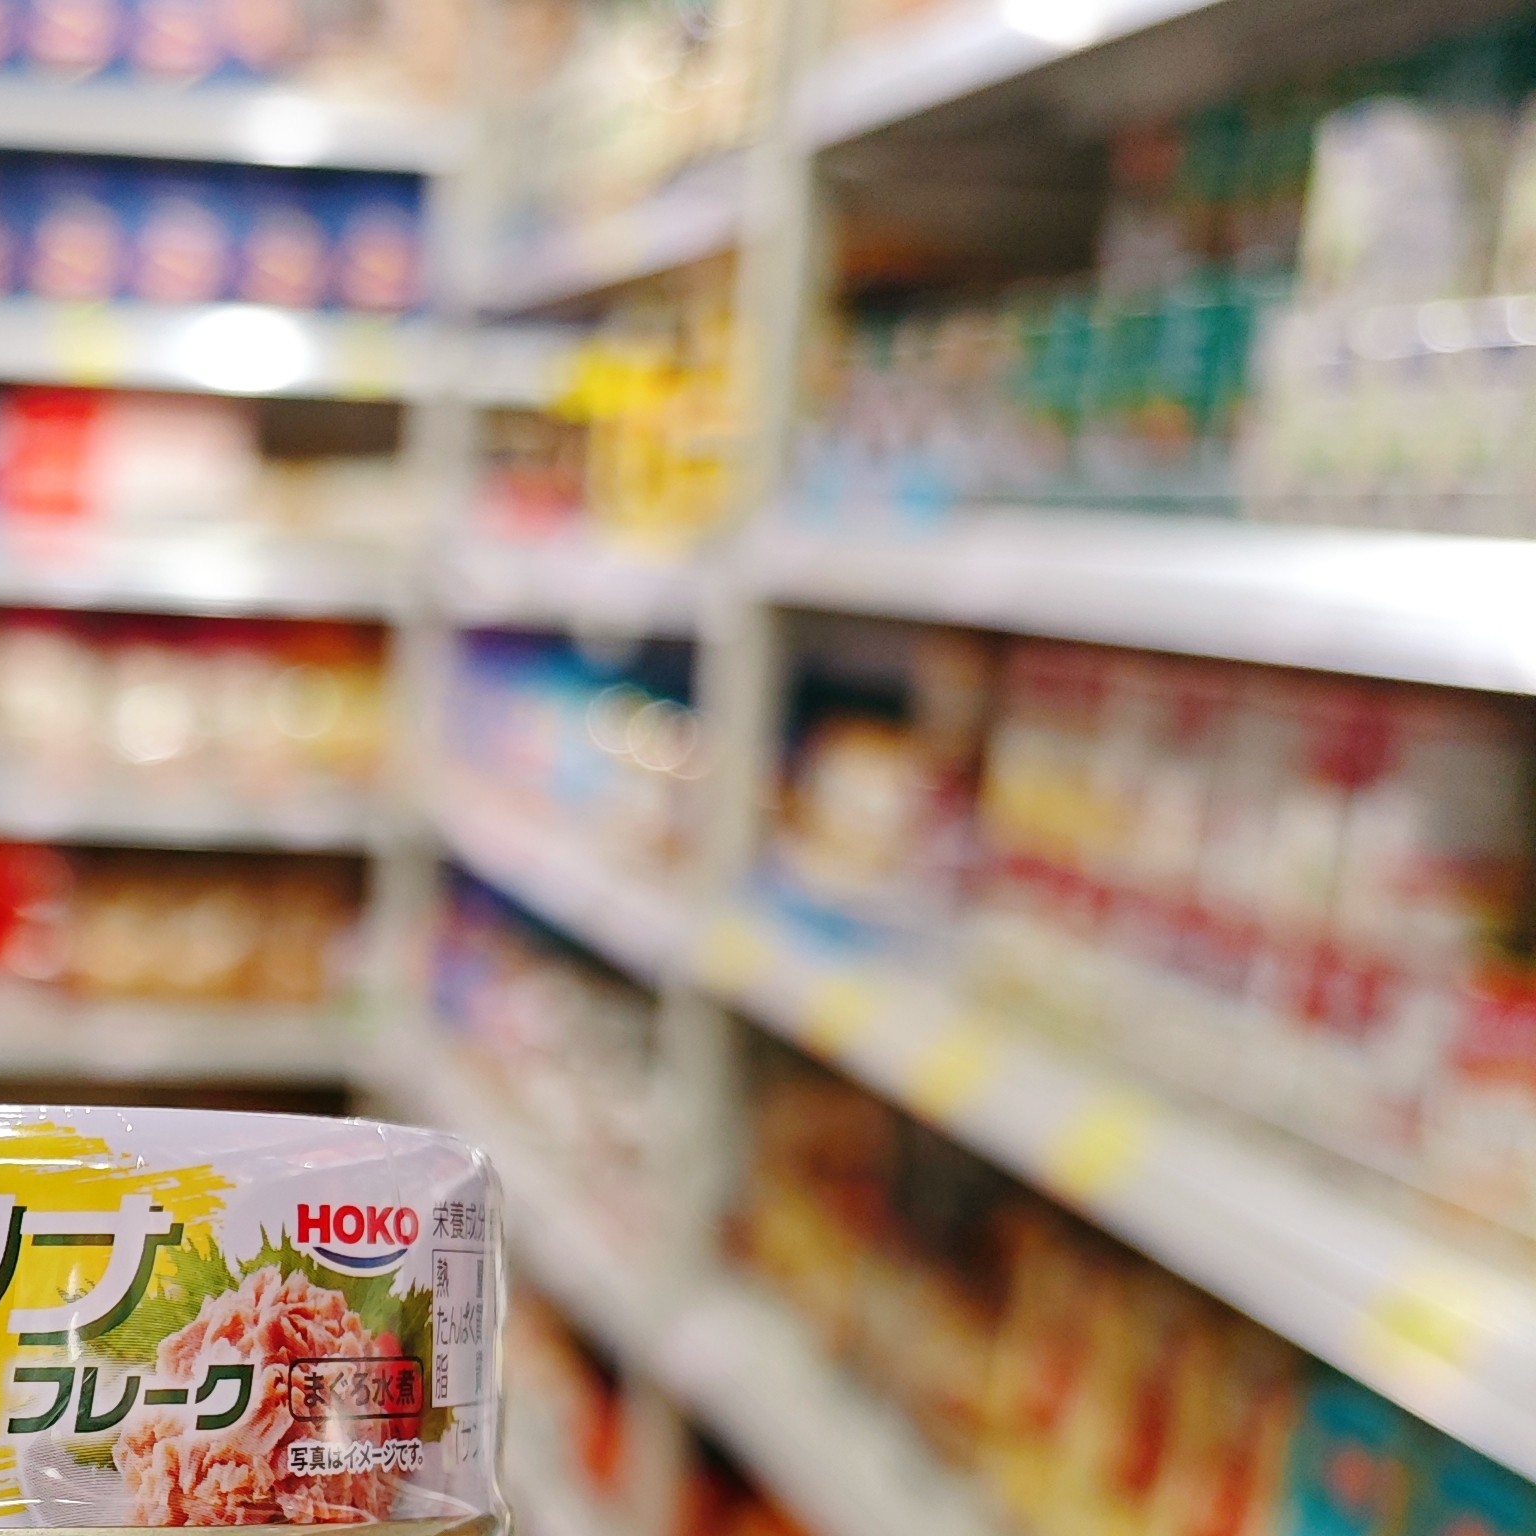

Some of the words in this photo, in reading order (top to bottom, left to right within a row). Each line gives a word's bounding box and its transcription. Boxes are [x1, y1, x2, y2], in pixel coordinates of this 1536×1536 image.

[297, 1203, 419, 1247] HOKO
[7, 1363, 255, 1434] フレーク
[302, 1371, 417, 1408] まぐろ水煮
